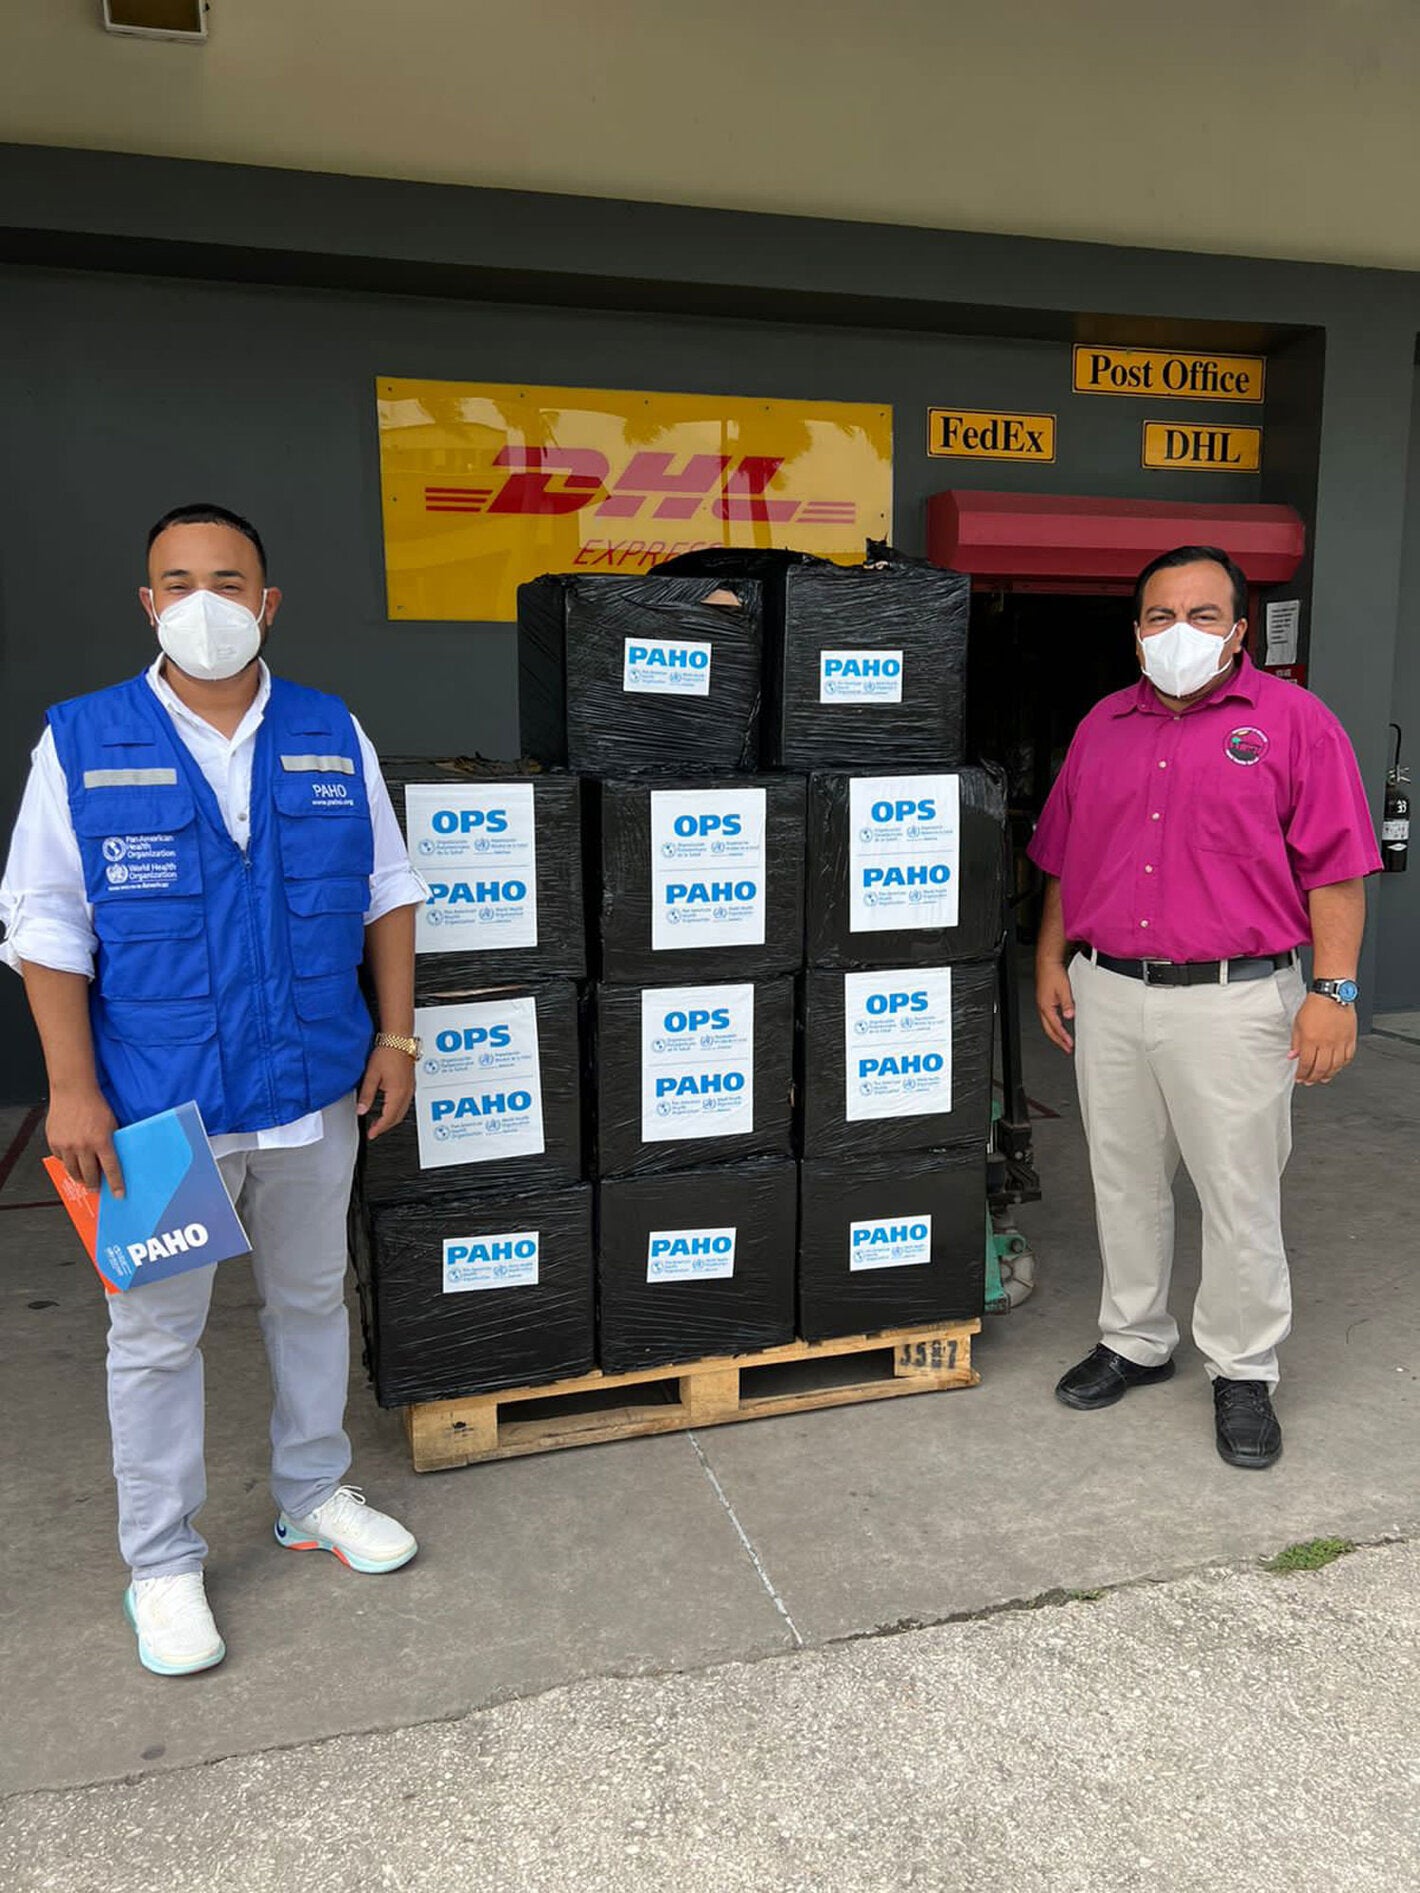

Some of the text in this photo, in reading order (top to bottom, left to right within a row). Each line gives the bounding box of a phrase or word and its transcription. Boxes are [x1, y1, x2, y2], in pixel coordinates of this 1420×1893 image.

[1089, 353, 1251, 394] Post Office
[939, 416, 1045, 454] FedEx
[1163, 429, 1241, 464] DHL
[487, 446, 802, 523] DHL
[573, 539, 722, 566] EXPRE
[628, 646, 708, 669] PAHO
[824, 658, 901, 678] PAHO
[312, 784, 347, 798] PAHO
[431, 809, 508, 836] OPS
[871, 799, 936, 823] OPS
[673, 813, 741, 838] OPS
[863, 864, 951, 888] PAHO
[426, 880, 526, 906] PAHO
[666, 881, 757, 905] PAHO
[866, 990, 929, 1015] OPS
[663, 1008, 730, 1033] OPS
[436, 1024, 511, 1053] OPS
[859, 1053, 943, 1078] PAHO
[655, 1072, 745, 1098] PAHO
[431, 1090, 532, 1122] PAHO
[127, 1223, 208, 1267] PAHO
[651, 1236, 732, 1258] PAHO
[853, 1223, 929, 1247] PAHO
[447, 1239, 536, 1266] PAHO
